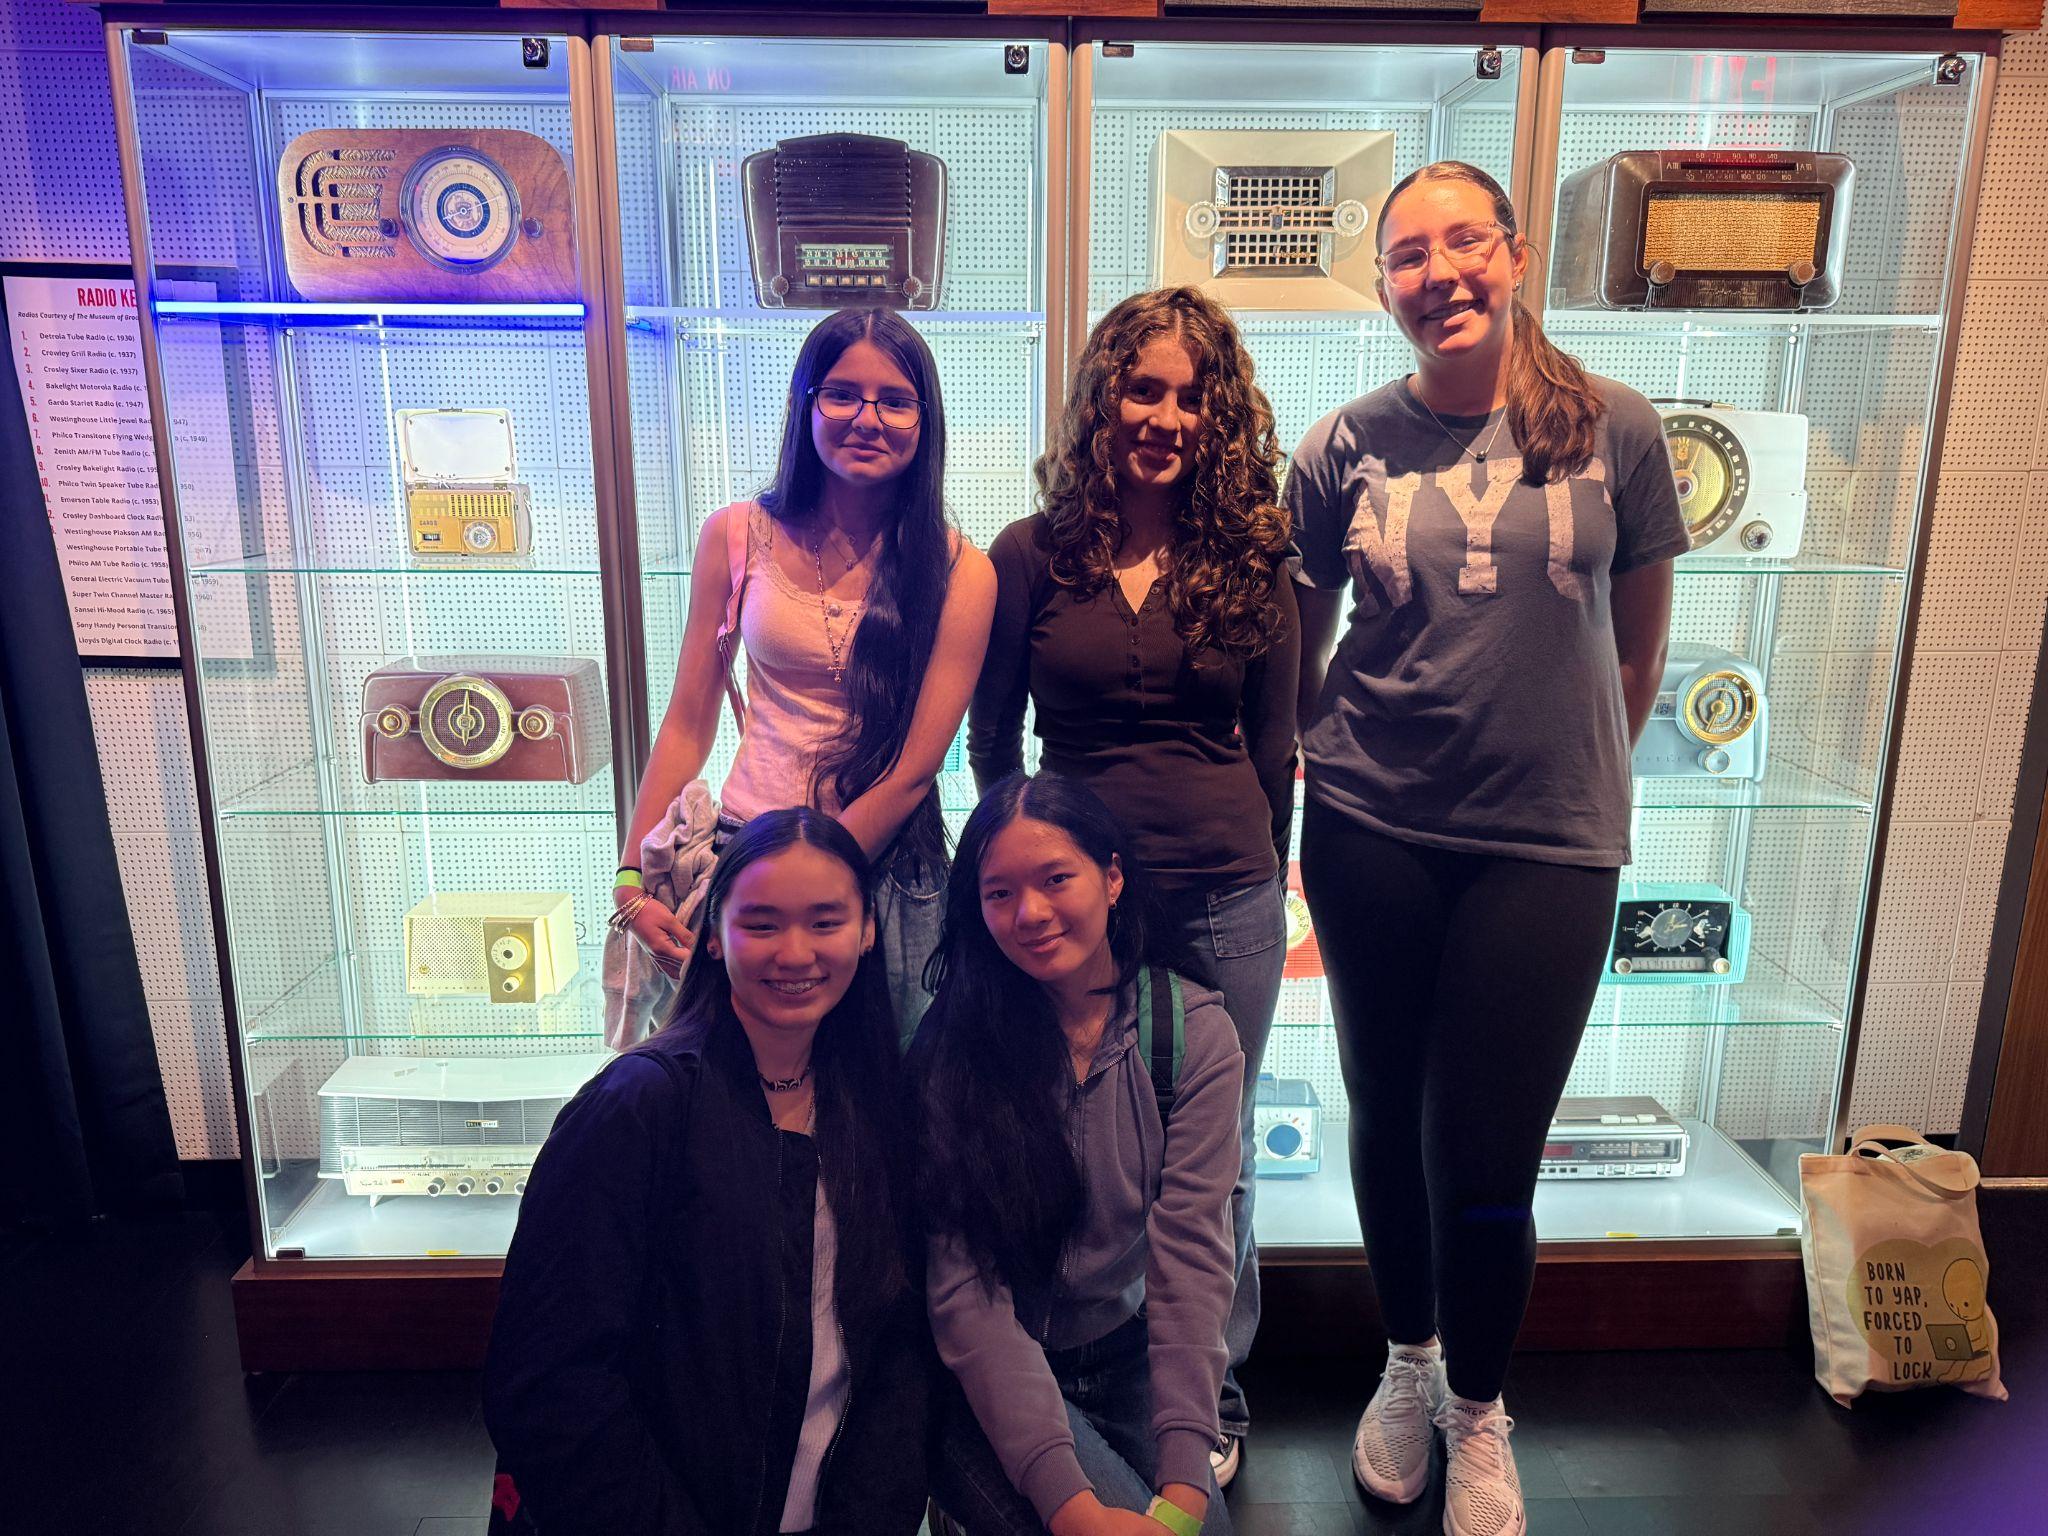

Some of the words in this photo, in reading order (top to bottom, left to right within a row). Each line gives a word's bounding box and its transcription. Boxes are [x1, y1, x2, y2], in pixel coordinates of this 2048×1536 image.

[77, 288, 117, 307] RADIO
[121, 288, 138, 308] KE
[40, 312, 67, 320] Courtesy
[117, 314, 124, 322] of
[22, 330, 28, 340] 1.
[107, 334, 115, 342] (c.
[117, 334, 135, 342] 1930)
[24, 347, 30, 357] 2.
[26, 364, 32, 374] 3.
[44, 366, 69, 374] Crosley
[110, 368, 118, 376] (c.
[120, 368, 138, 376] 1937)
[28, 380, 34, 390] 4.
[46, 382, 78, 391] Bakelight
[30, 396, 36, 406] 5.
[32, 413, 39, 422] 6.
[50, 416, 98, 424] Westinghouse
[34, 429, 40, 439] 7.
[74, 432, 111, 440] Transitone
[113, 434, 132, 442] Flying
[134, 434, 153, 442] Wedg
[36, 445, 44, 455] 8.
[78, 448, 102, 456] AM/FM
[142, 450, 150, 458] (c.
[38, 462, 46, 471] 9.
[56, 464, 81, 472] Crosley
[83, 465, 115, 473] Bakelight
[137, 466, 146, 474] (c.
[58, 480, 79, 488] Philco
[98, 482, 126, 490] Speaker
[60, 496, 90, 504] Emerson
[132, 498, 140, 506] (c.
[142, 498, 159, 506] 1953)
[62, 512, 88, 520] Crosley
[64, 528, 112, 536] Westinghouse
[66, 544, 114, 552] Westinghouse
[72, 591, 92, 599] Super
[76, 622, 92, 630] Sony
[94, 622, 116, 630] Handy
[116, 622, 146, 630] Personal
[144, 638, 162, 646] Radio
[1866, 1261, 1906, 1281] BORN
[1864, 1286, 1883, 1306] TO
[1893, 1286, 1928, 1308] YAP,
[1863, 1311, 1922, 1331] FORCED
[1894, 1336, 1912, 1355] TO
[1894, 1361, 1931, 1381] LOCK
